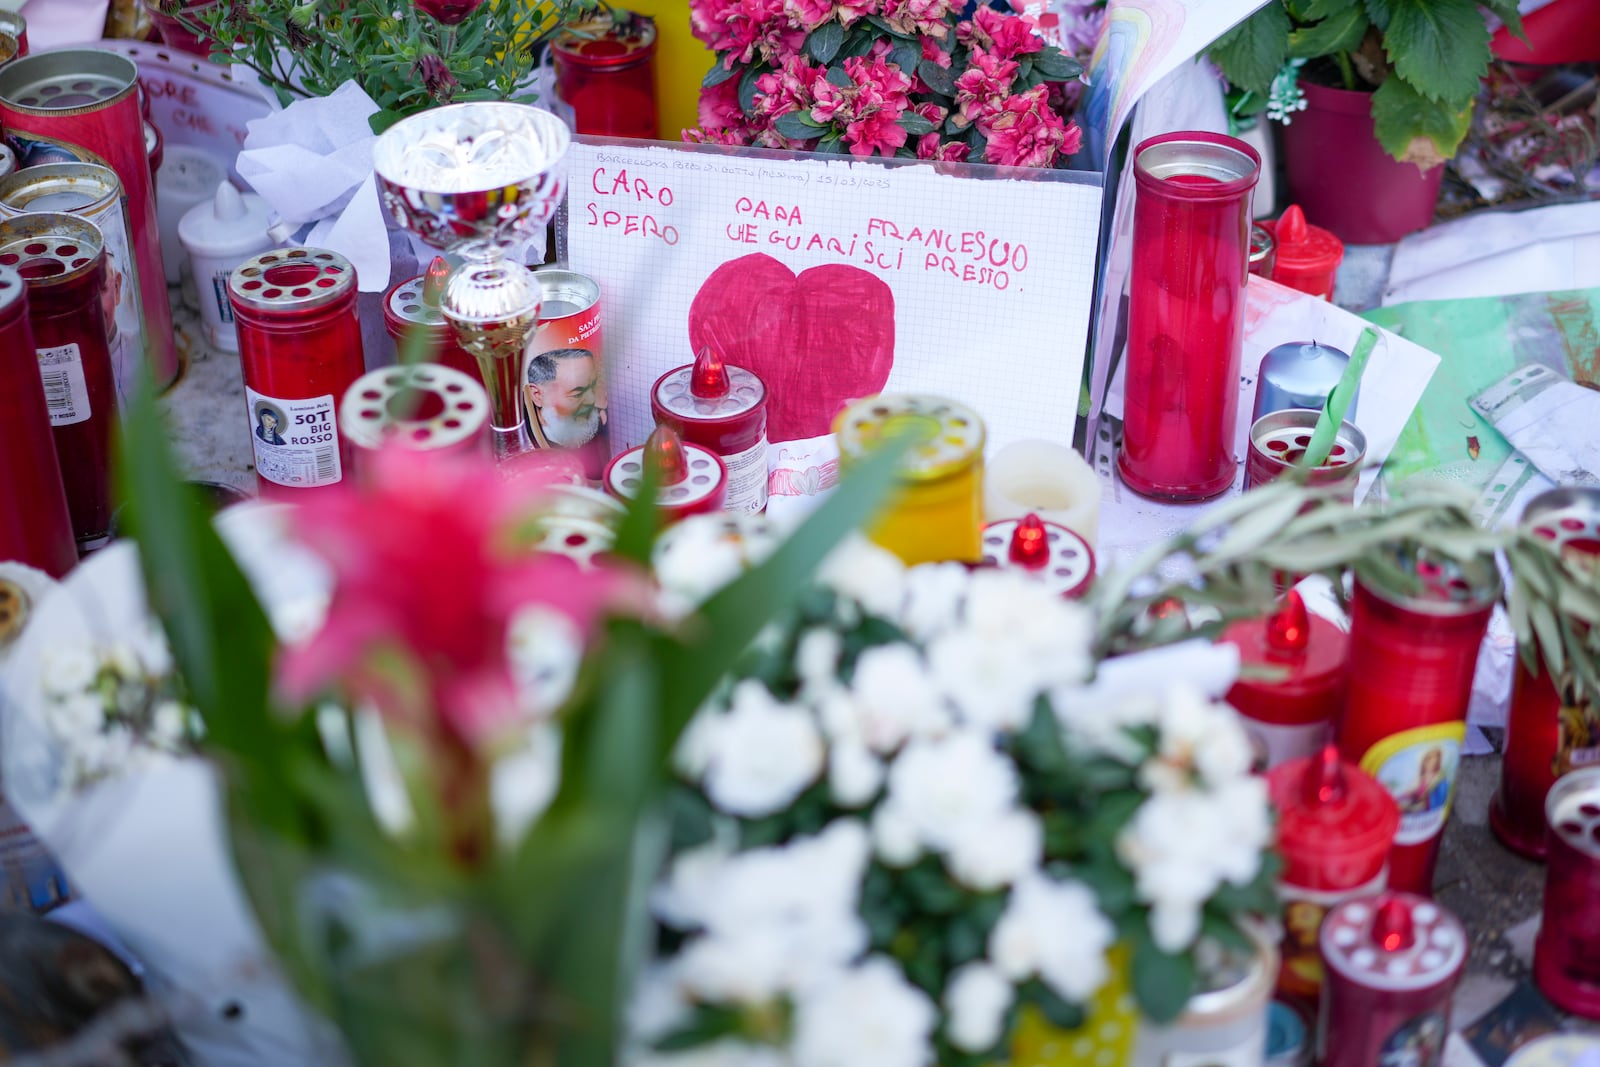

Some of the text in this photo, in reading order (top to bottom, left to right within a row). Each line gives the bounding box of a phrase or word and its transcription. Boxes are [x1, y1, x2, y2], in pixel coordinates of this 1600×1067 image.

[592, 167, 674, 207] CARO
[736, 197, 803, 226] PAPA
[587, 202, 680, 246] SPERO
[727, 223, 759, 244] CHE
[578, 320, 594, 334] SAN
[568, 336, 579, 345] DA
[295, 409, 331, 425] 50T
[310, 422, 332, 434] BIG
[291, 432, 333, 446] ROSSO
